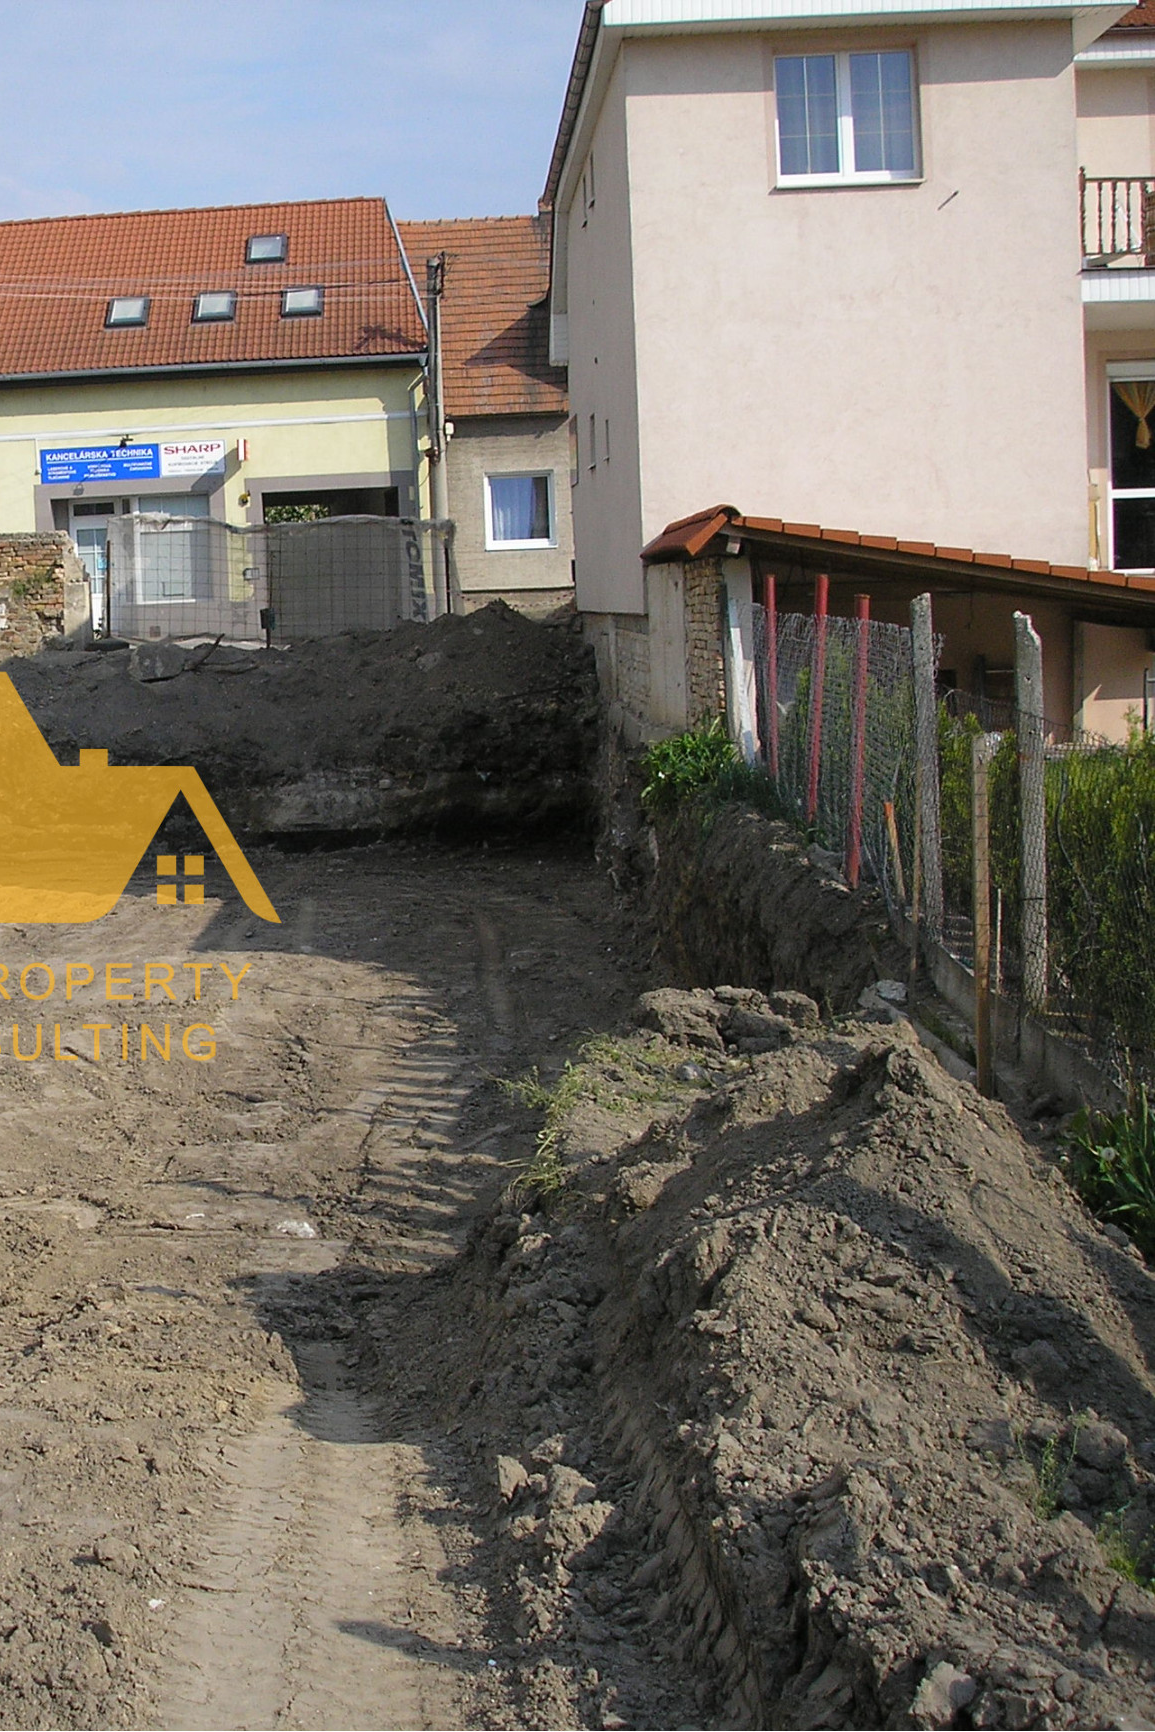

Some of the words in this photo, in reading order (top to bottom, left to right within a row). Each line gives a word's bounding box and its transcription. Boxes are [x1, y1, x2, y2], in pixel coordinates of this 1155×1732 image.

[46, 450, 108, 461] KANCELÁRSKA
[111, 448, 153, 458] TECHNIKA
[164, 443, 221, 455] SHARP
